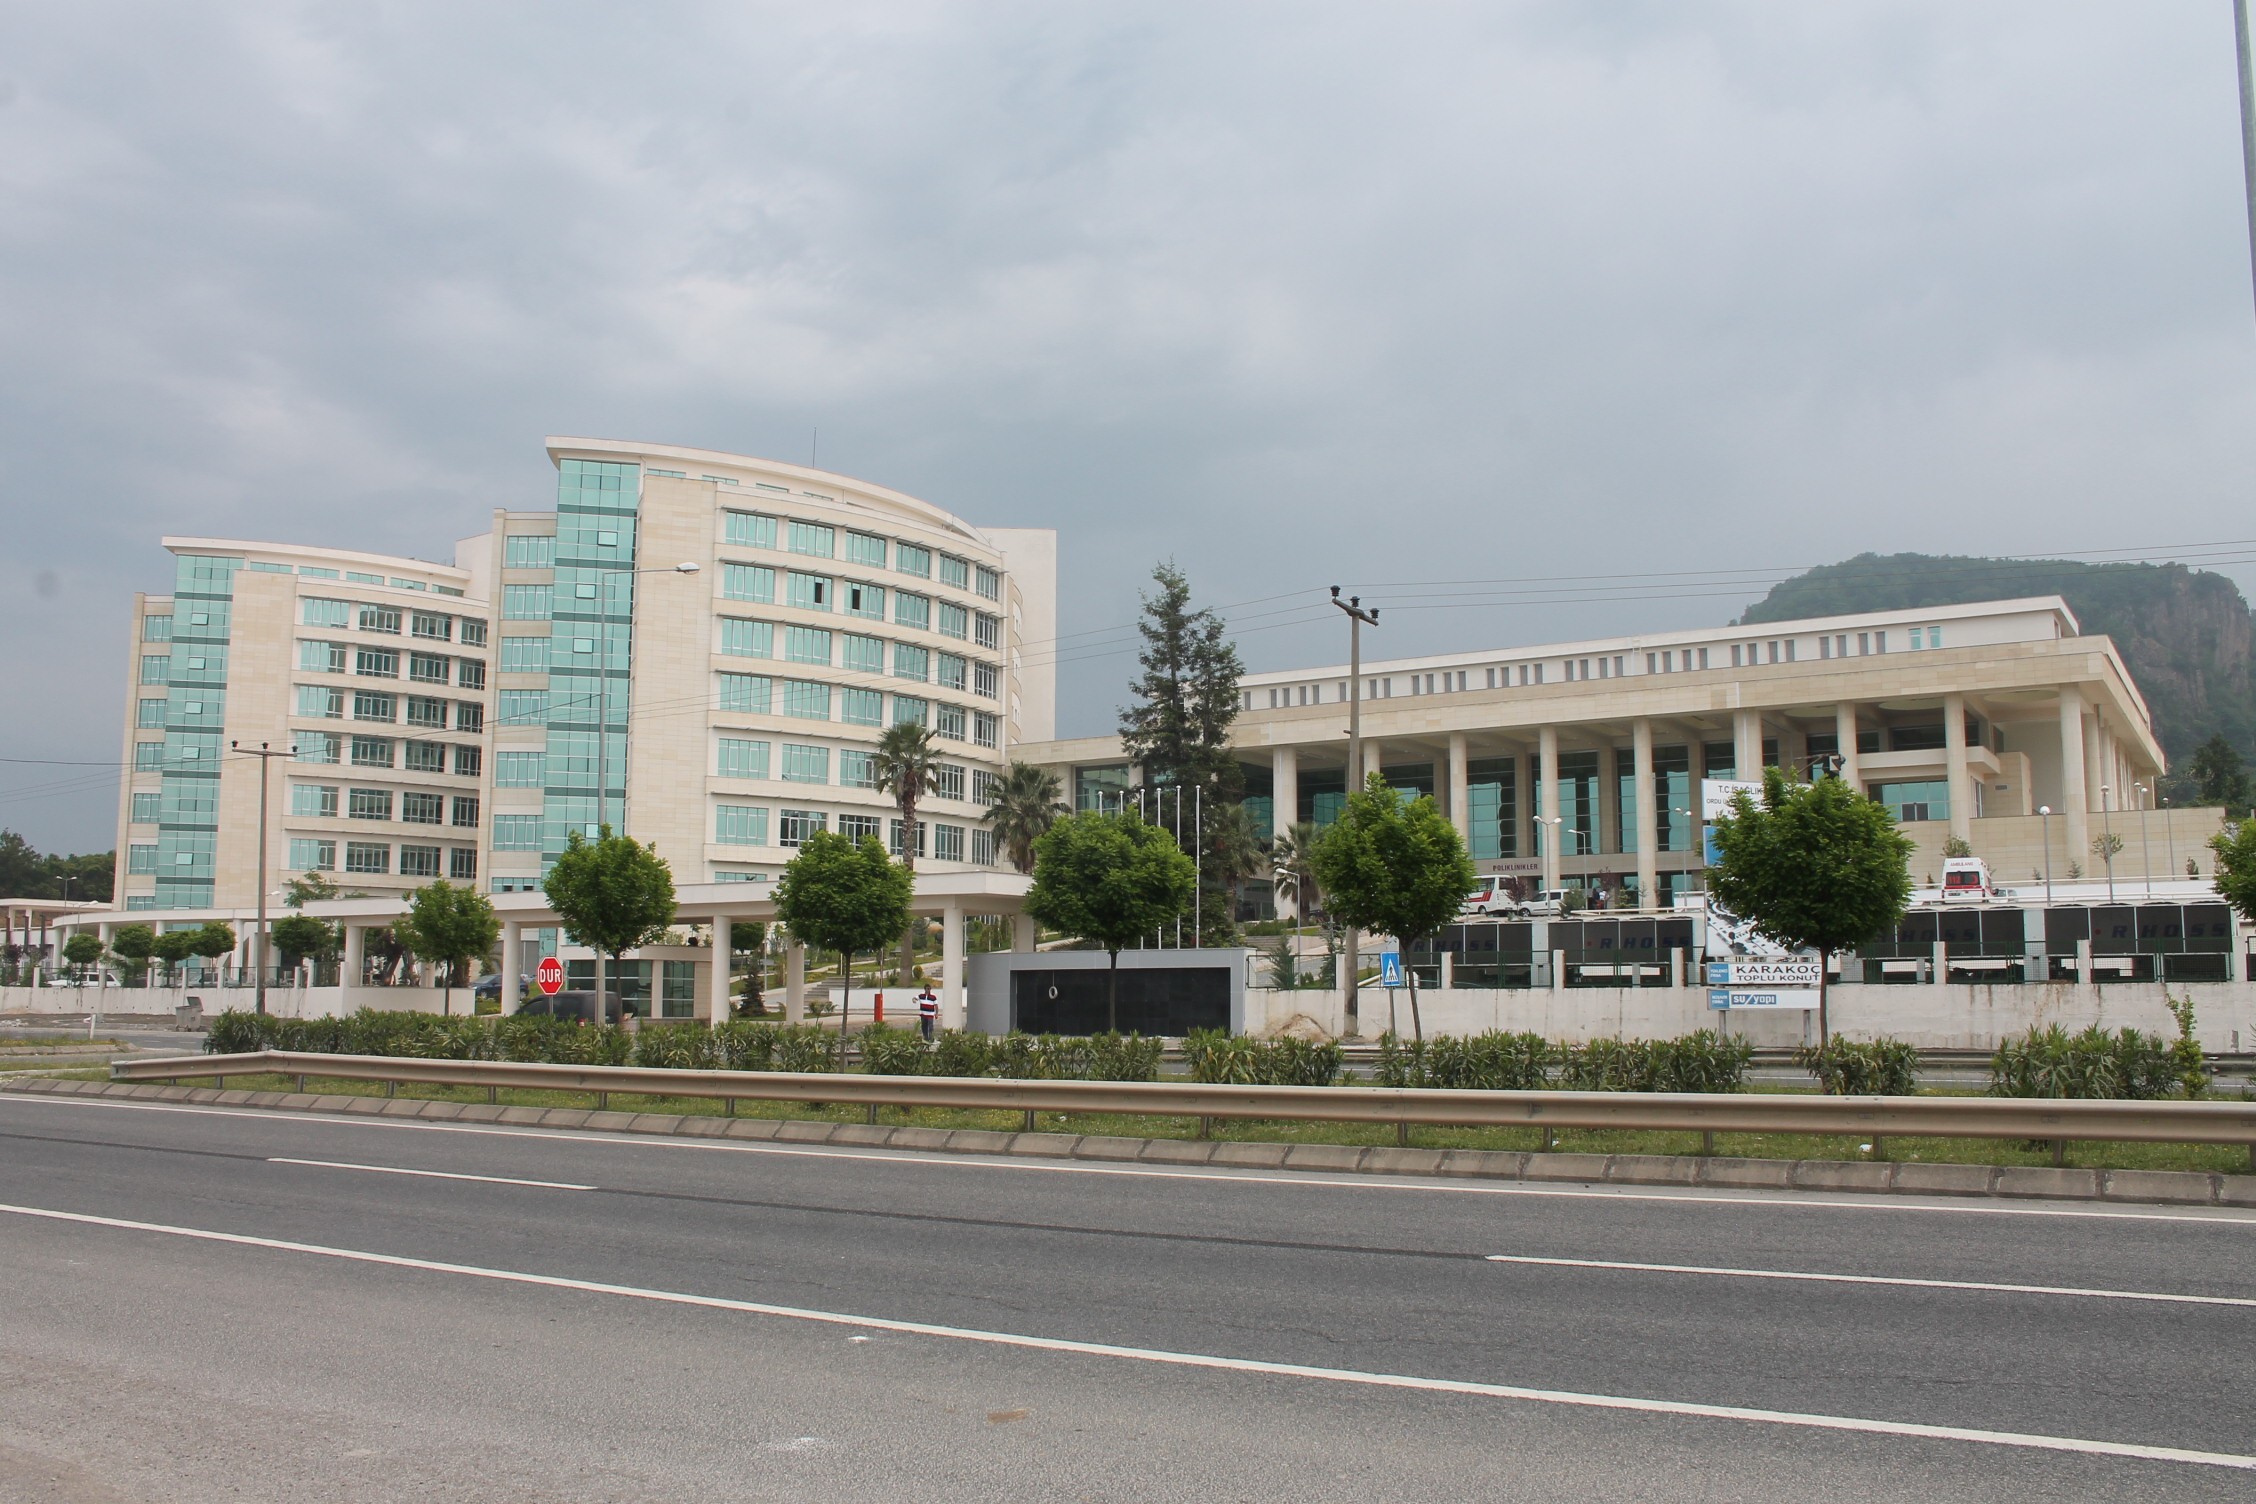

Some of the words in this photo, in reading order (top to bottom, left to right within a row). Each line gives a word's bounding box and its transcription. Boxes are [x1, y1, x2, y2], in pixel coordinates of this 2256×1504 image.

[2112, 922, 2228, 938] RHOSS
[1414, 940, 1497, 953] RHOSS
[1600, 935, 1691, 950] RHOSS
[540, 968, 561, 983] DUR
[1736, 965, 1821, 975] KARAKOÇ
